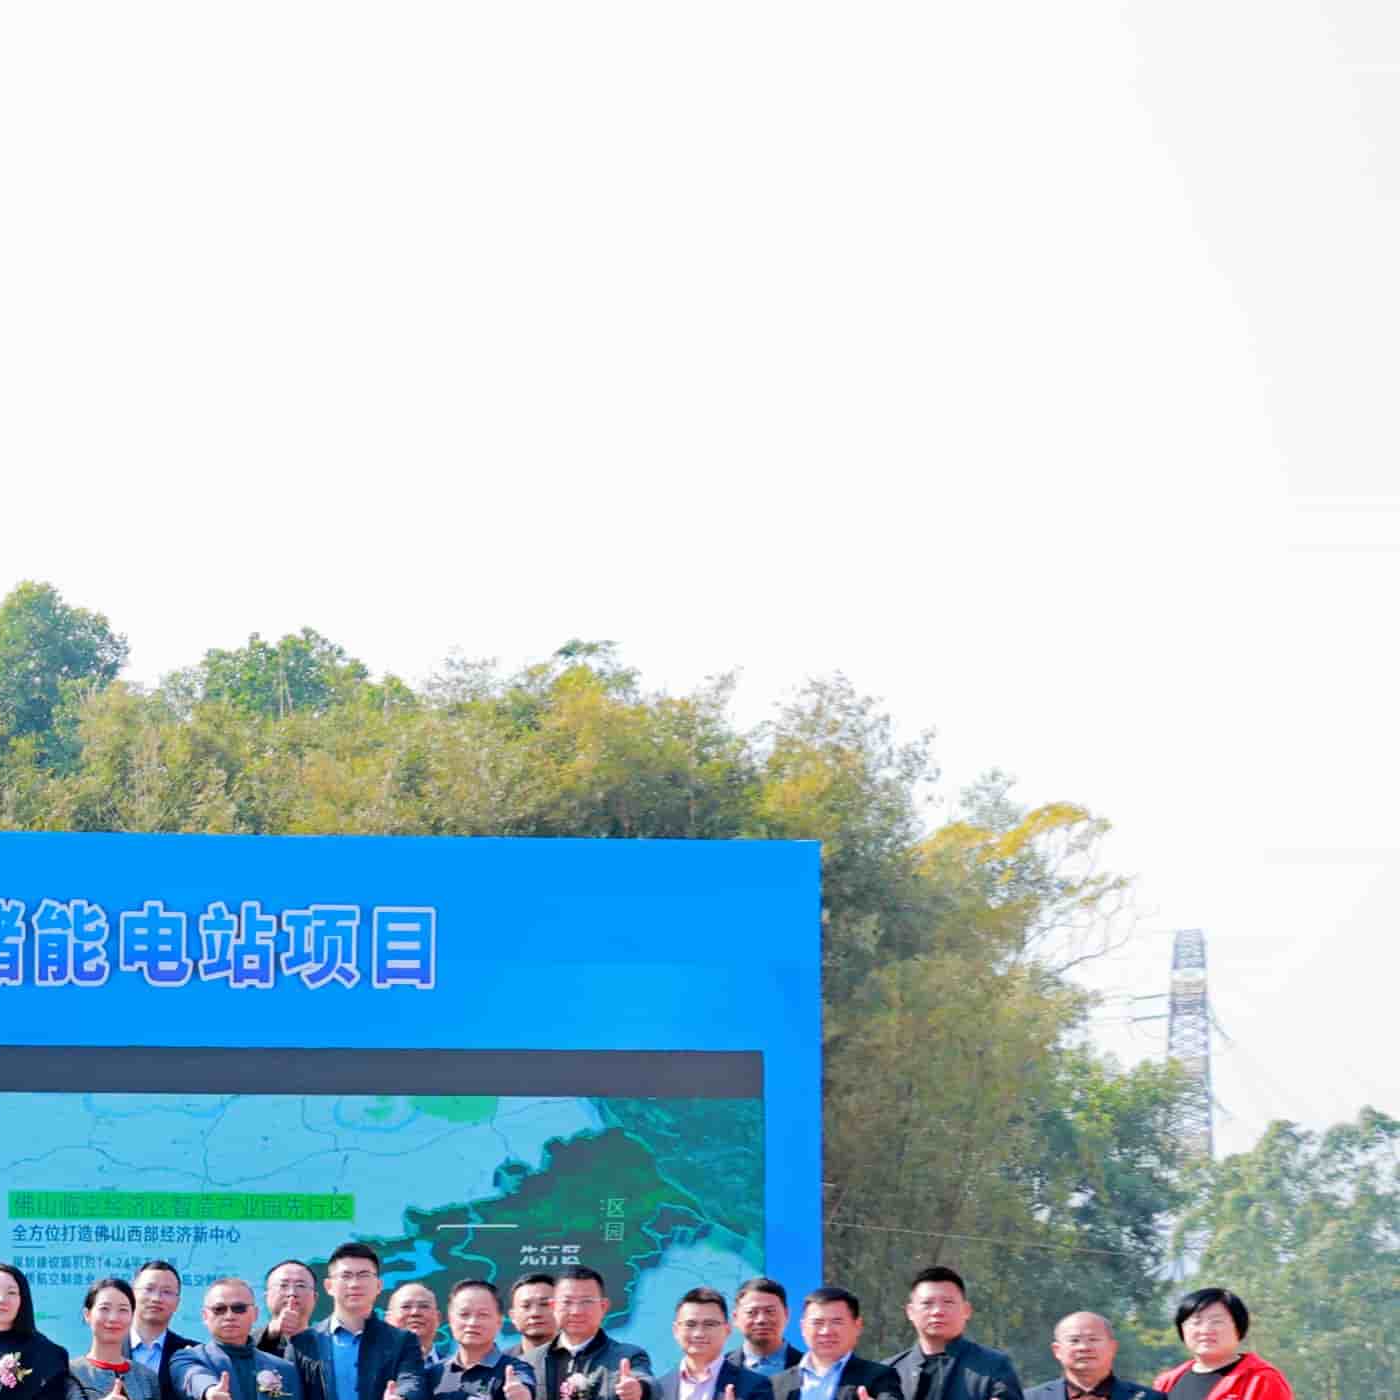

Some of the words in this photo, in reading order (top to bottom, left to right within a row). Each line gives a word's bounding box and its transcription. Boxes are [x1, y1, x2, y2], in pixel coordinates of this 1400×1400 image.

[12, 1224, 241, 1244] 全方位打造佛山西部经济新中心
